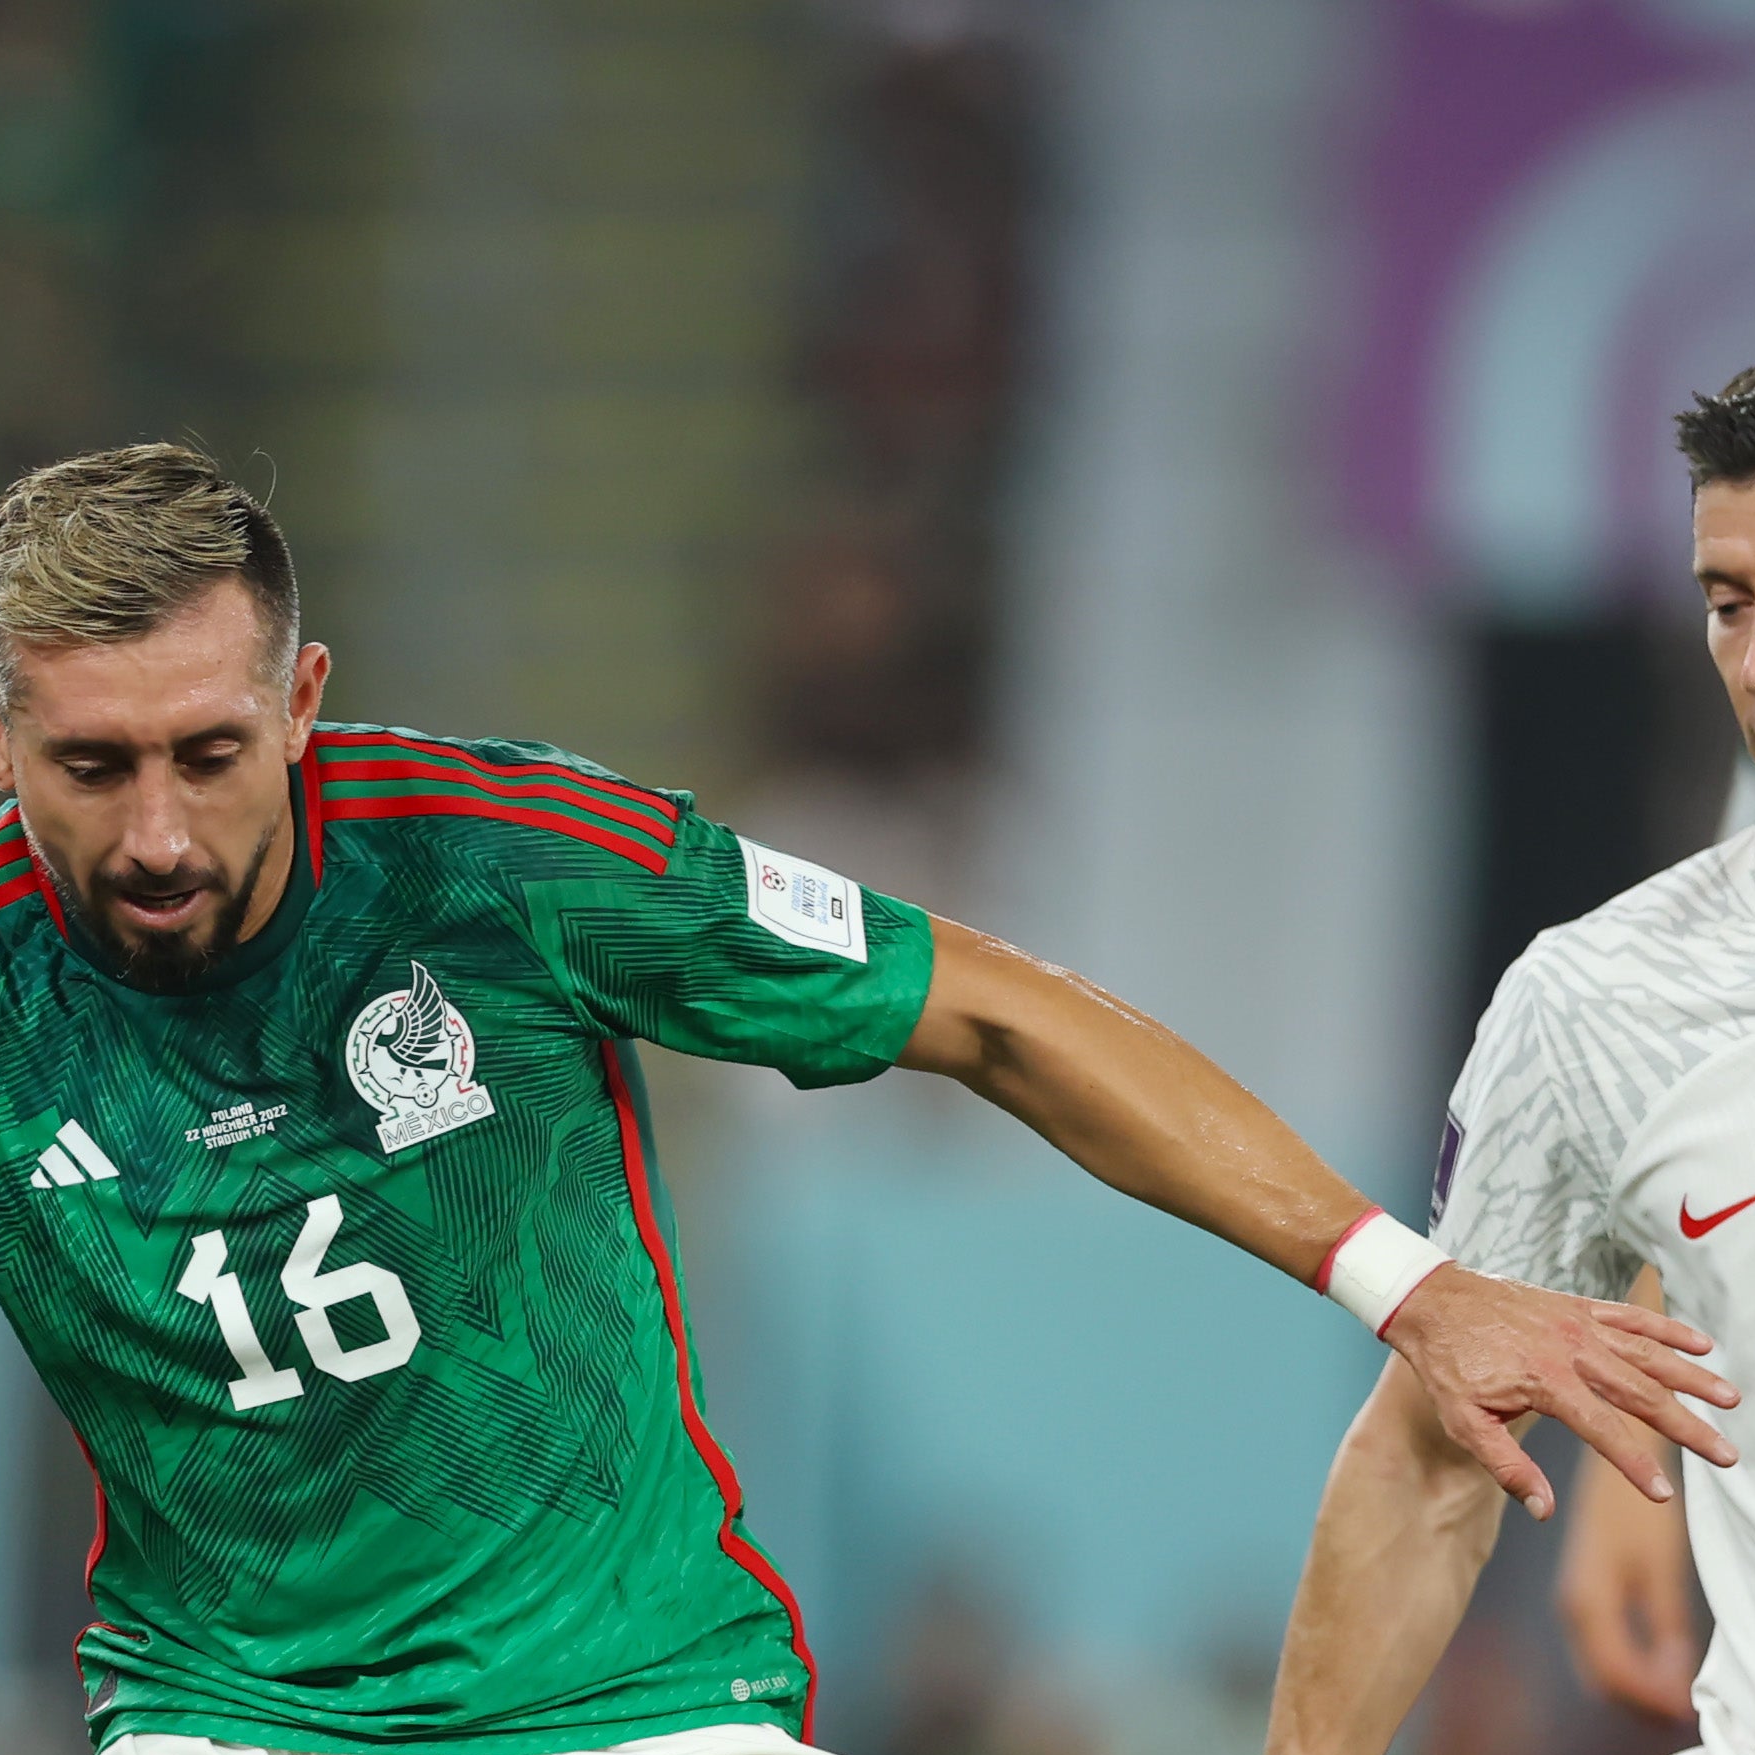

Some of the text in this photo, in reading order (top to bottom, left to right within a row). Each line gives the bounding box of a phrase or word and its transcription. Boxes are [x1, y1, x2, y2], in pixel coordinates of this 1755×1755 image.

[801, 875, 816, 919] UNITES
[185, 1104, 288, 1142] 22 NOVEMBER 2022
[211, 1102, 254, 1123] POLAND
[381, 1093, 488, 1149] MÉXICO
[205, 1121, 275, 1150] STADIUM 974
[176, 1193, 422, 1411] 16
